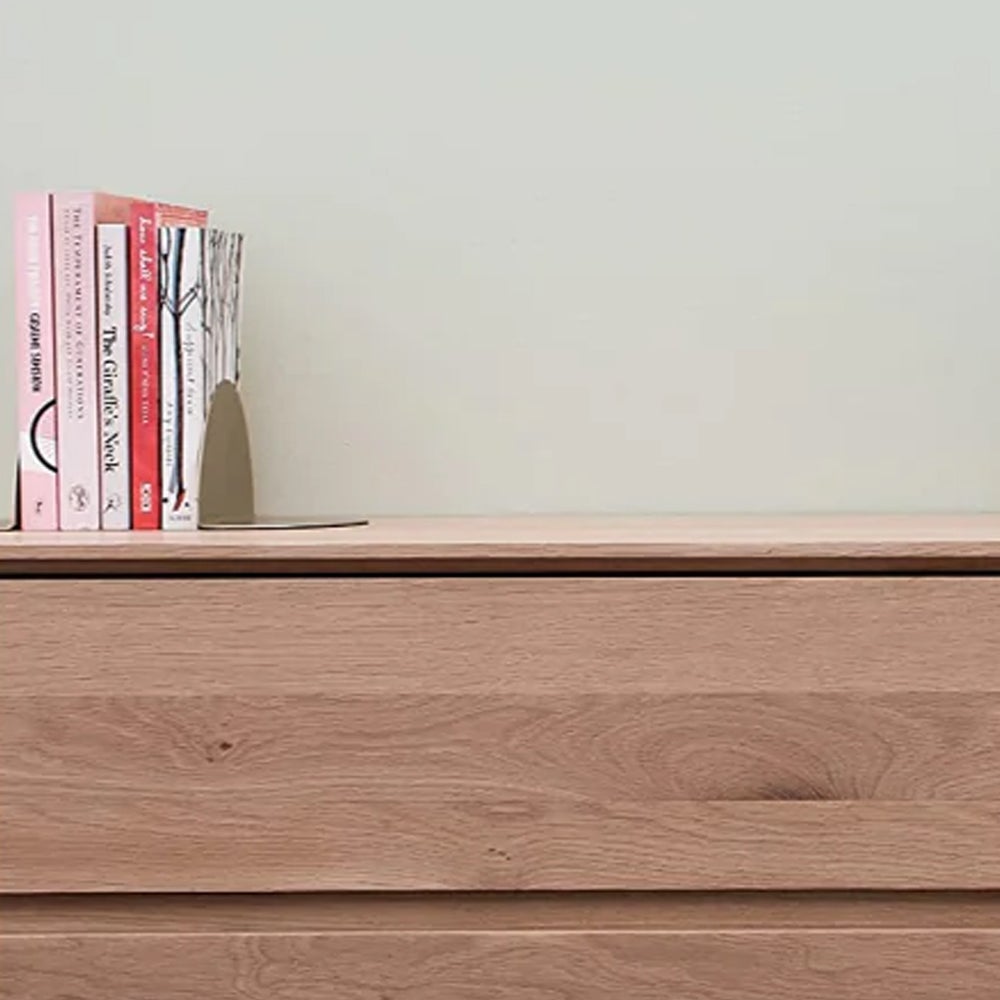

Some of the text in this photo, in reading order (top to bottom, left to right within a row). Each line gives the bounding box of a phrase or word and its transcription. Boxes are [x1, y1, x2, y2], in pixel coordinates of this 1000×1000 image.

[102, 325, 120, 473] The Giraffe's Neck
